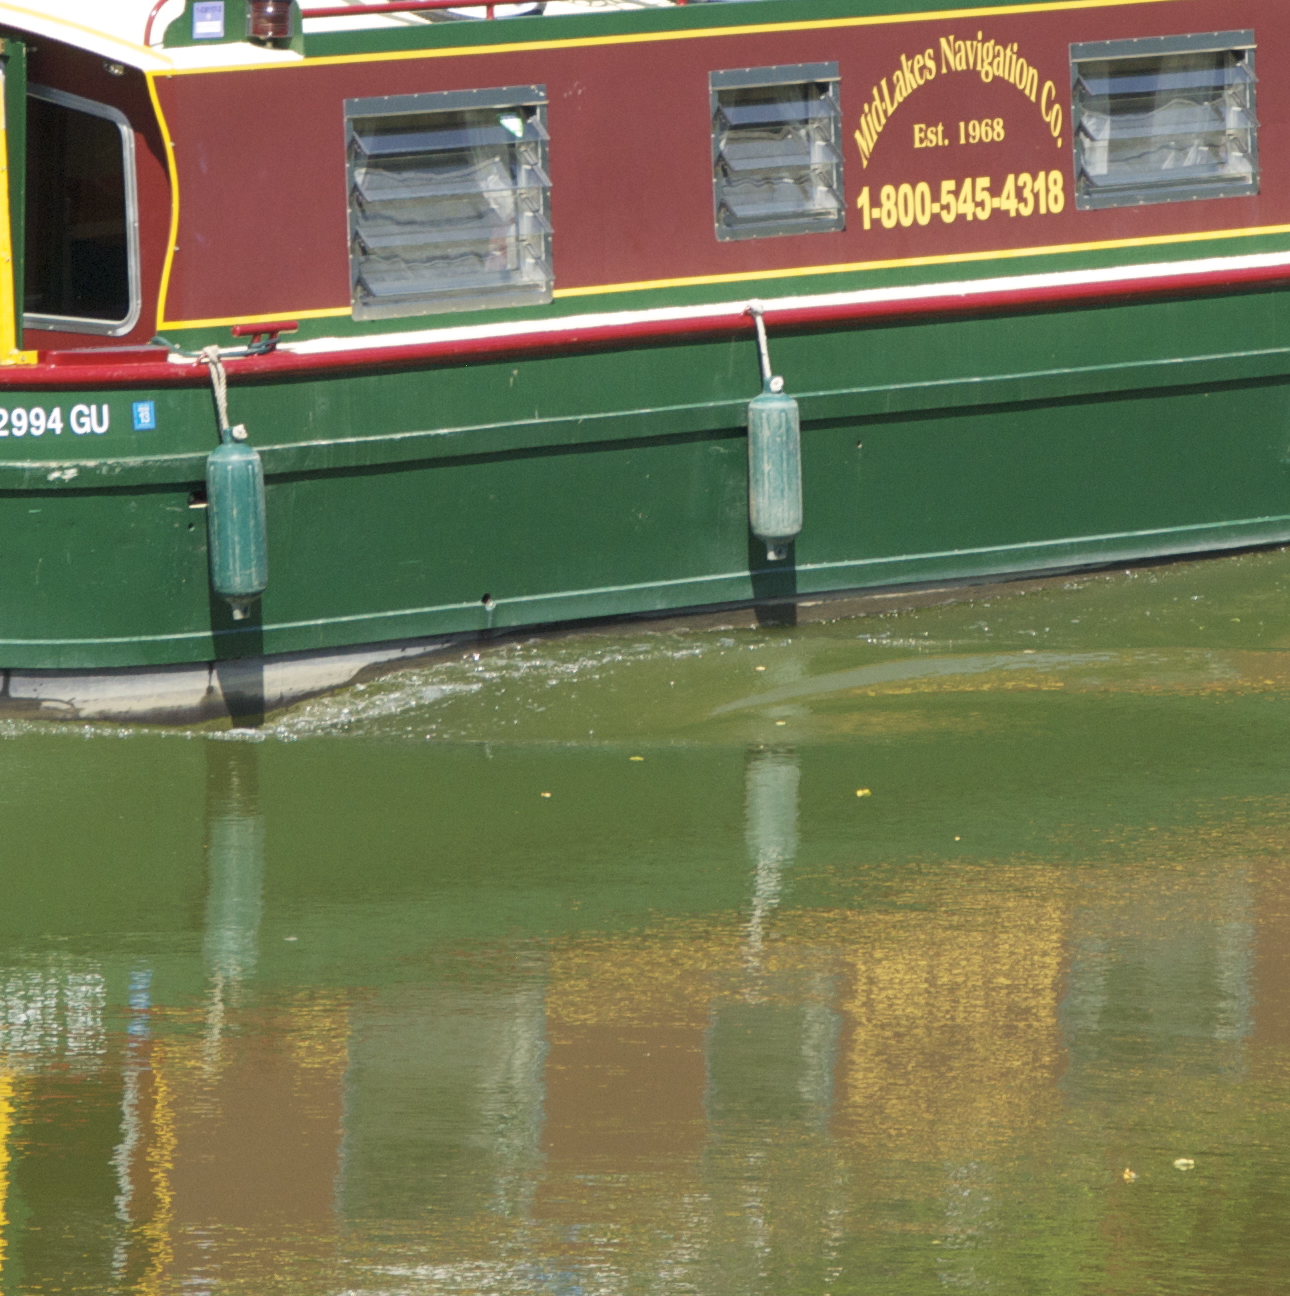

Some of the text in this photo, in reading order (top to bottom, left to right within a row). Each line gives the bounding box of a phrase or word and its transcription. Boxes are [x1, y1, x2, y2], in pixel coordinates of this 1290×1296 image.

[854, 30, 1062, 169] Mid-Lakes Navigation Co.
[913, 117, 1005, 148] Est. 1968
[857, 170, 1064, 230] 1-800-545-4318
[70, 404, 109, 435] GU
